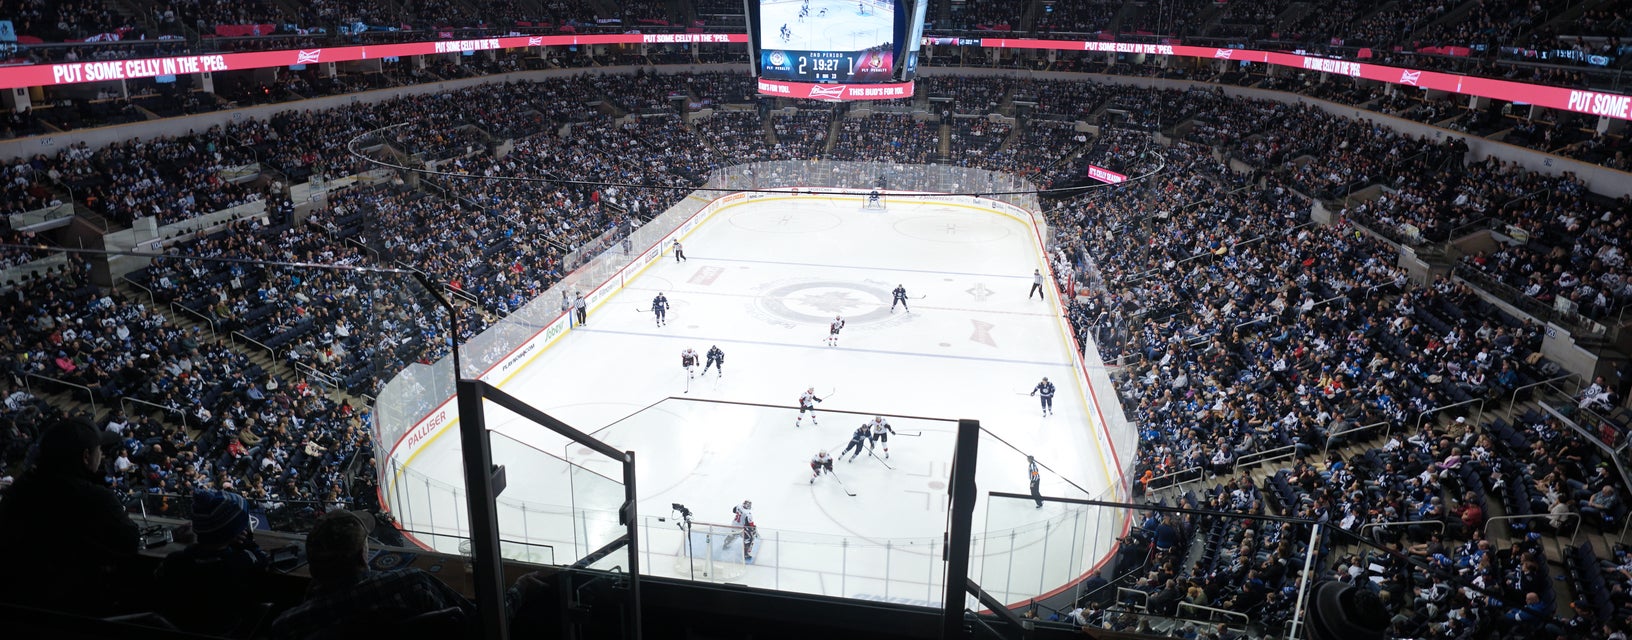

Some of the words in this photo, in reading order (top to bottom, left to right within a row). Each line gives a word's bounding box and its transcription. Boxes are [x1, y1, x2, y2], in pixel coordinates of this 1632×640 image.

[644, 34, 656, 42] PUT
[657, 34, 674, 42] SOME
[675, 34, 692, 42] CELLY
[693, 34, 700, 42] IN
[700, 34, 712, 42] THE
[435, 42, 445, 52] PUT
[446, 41, 460, 52] SOME
[1085, 42, 1098, 50] PUT
[1099, 42, 1116, 51] SOME
[1117, 43, 1135, 52] CELLY
[1135, 44, 1143, 53] IN
[1143, 44, 1156, 54] THE
[52, 64, 82, 84] PUT
[85, 62, 124, 81] SOME
[125, 59, 160, 78] CELLY
[162, 57, 176, 75] IN
[177, 56, 199, 73] THE
[799, 56, 807, 74] 2
[812, 59, 838, 71] 19:27
[847, 57, 855, 75] 1
[849, 88, 864, 96] THIS
[1568, 90, 1593, 112] PUT
[1592, 94, 1630, 118] SOME
[408, 410, 446, 450] PALLISER
